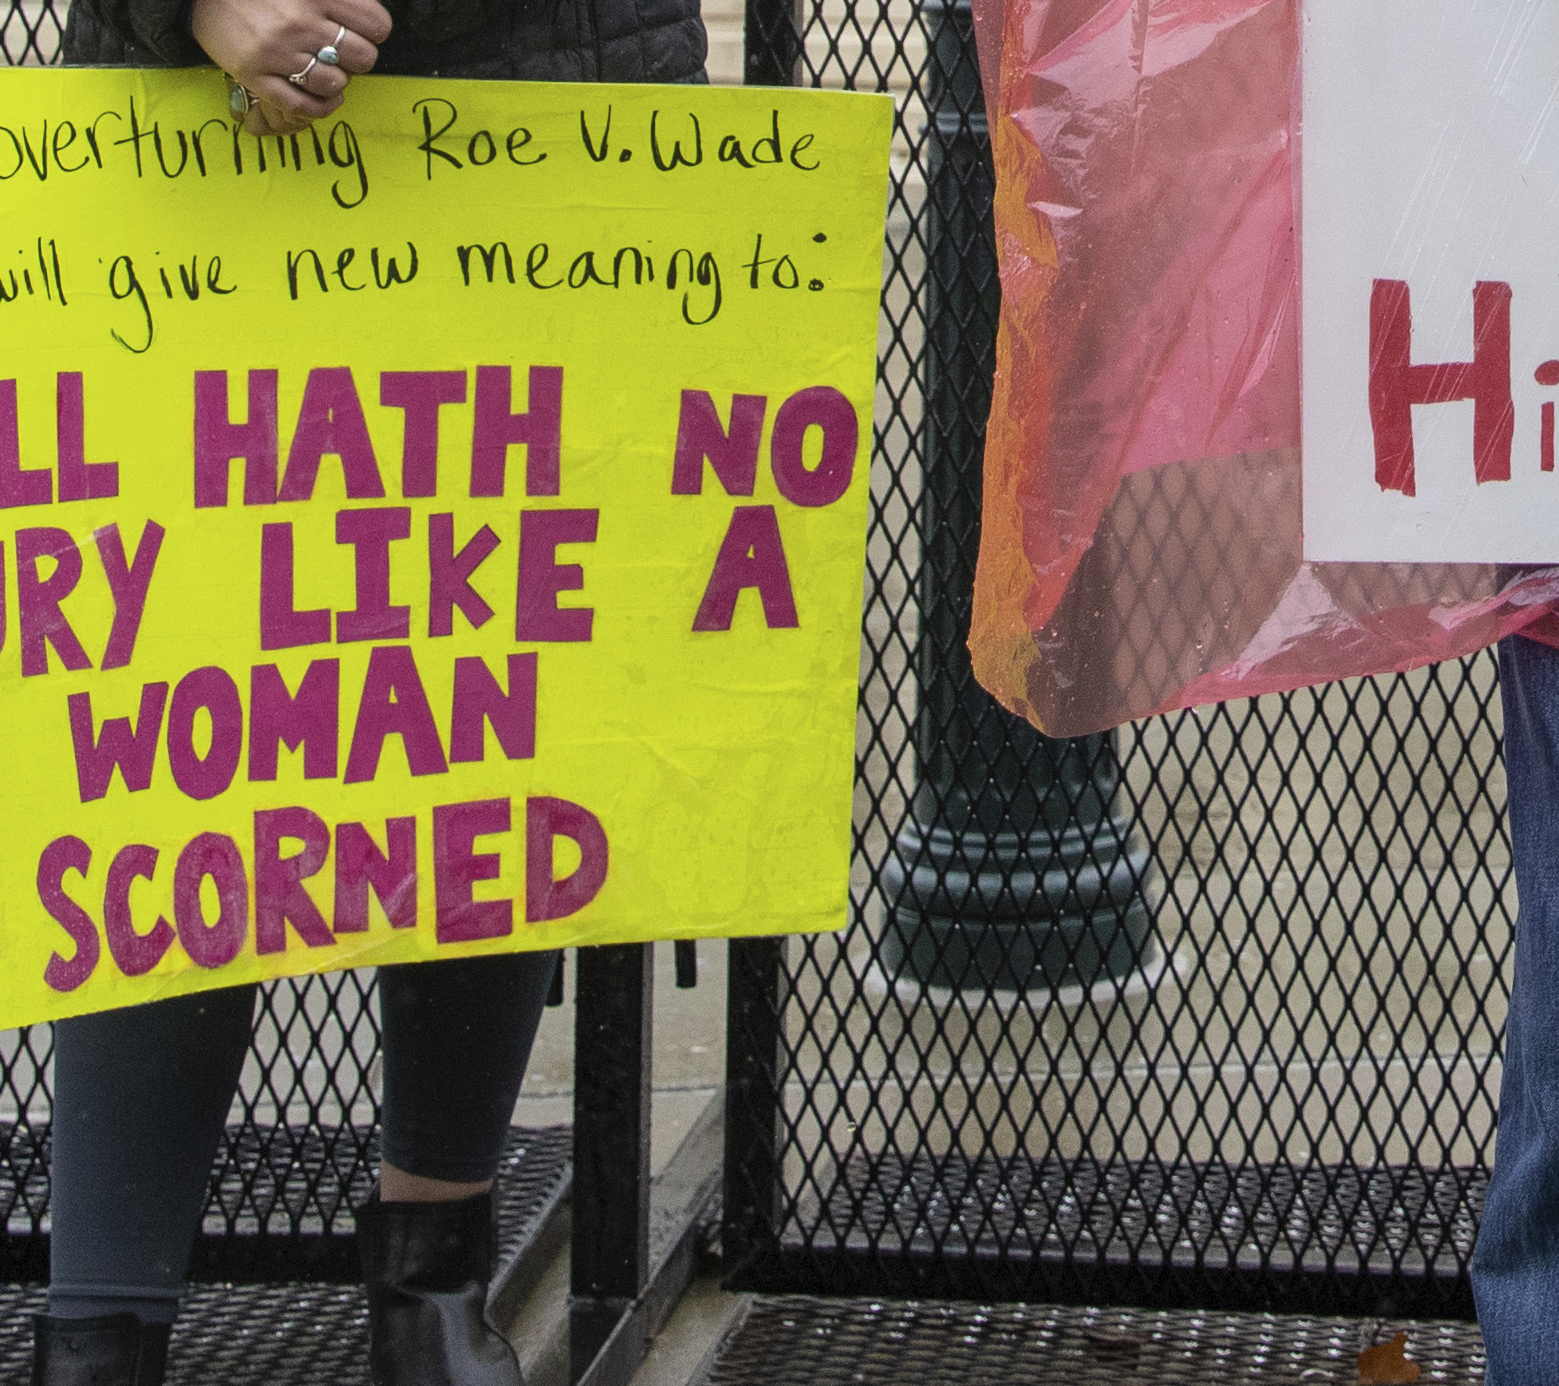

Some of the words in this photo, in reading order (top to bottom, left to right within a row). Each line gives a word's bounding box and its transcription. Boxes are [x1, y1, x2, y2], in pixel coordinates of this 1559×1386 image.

[412, 97, 548, 181] Roe
[650, 109, 821, 173] Wade
[108, 251, 238, 354] give
[287, 240, 419, 301] new
[457, 239, 723, 326] meaning
[742, 232, 829, 293] to:
[193, 365, 564, 509] HATH
[671, 385, 858, 508] NO
[259, 507, 599, 652] LIKE
[693, 504, 799, 633] A
[66, 645, 539, 804] WOMAN
[36, 796, 609, 994] SCORNED
